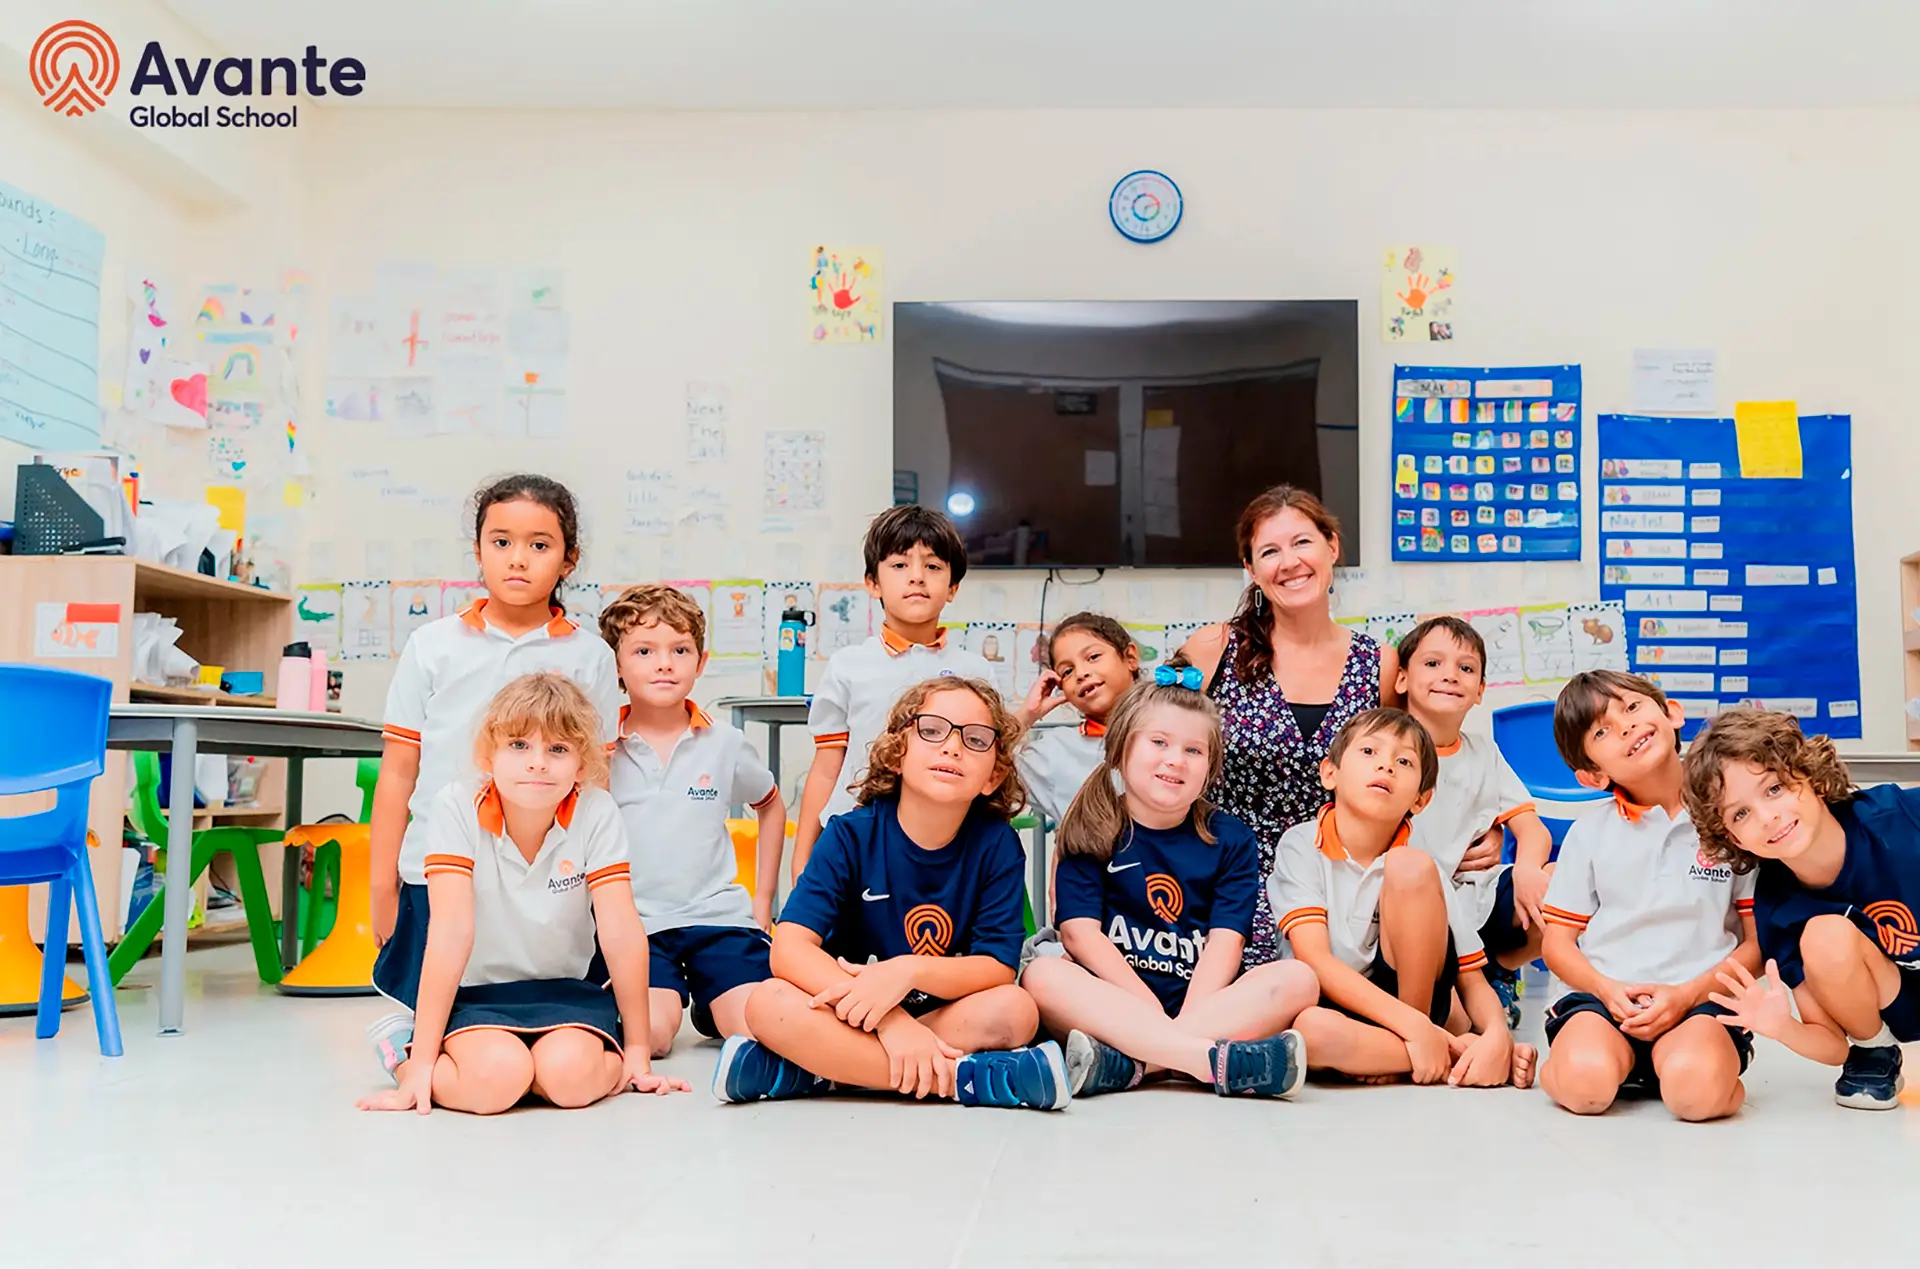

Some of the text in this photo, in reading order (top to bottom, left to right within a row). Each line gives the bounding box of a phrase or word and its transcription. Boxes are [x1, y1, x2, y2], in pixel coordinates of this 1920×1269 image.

[687, 786, 718, 797] Avante
[1688, 865, 1731, 878] Avante
[548, 872, 586, 889] Avante
[1108, 915, 1206, 963] Avant
[1124, 954, 1173, 973] Global
